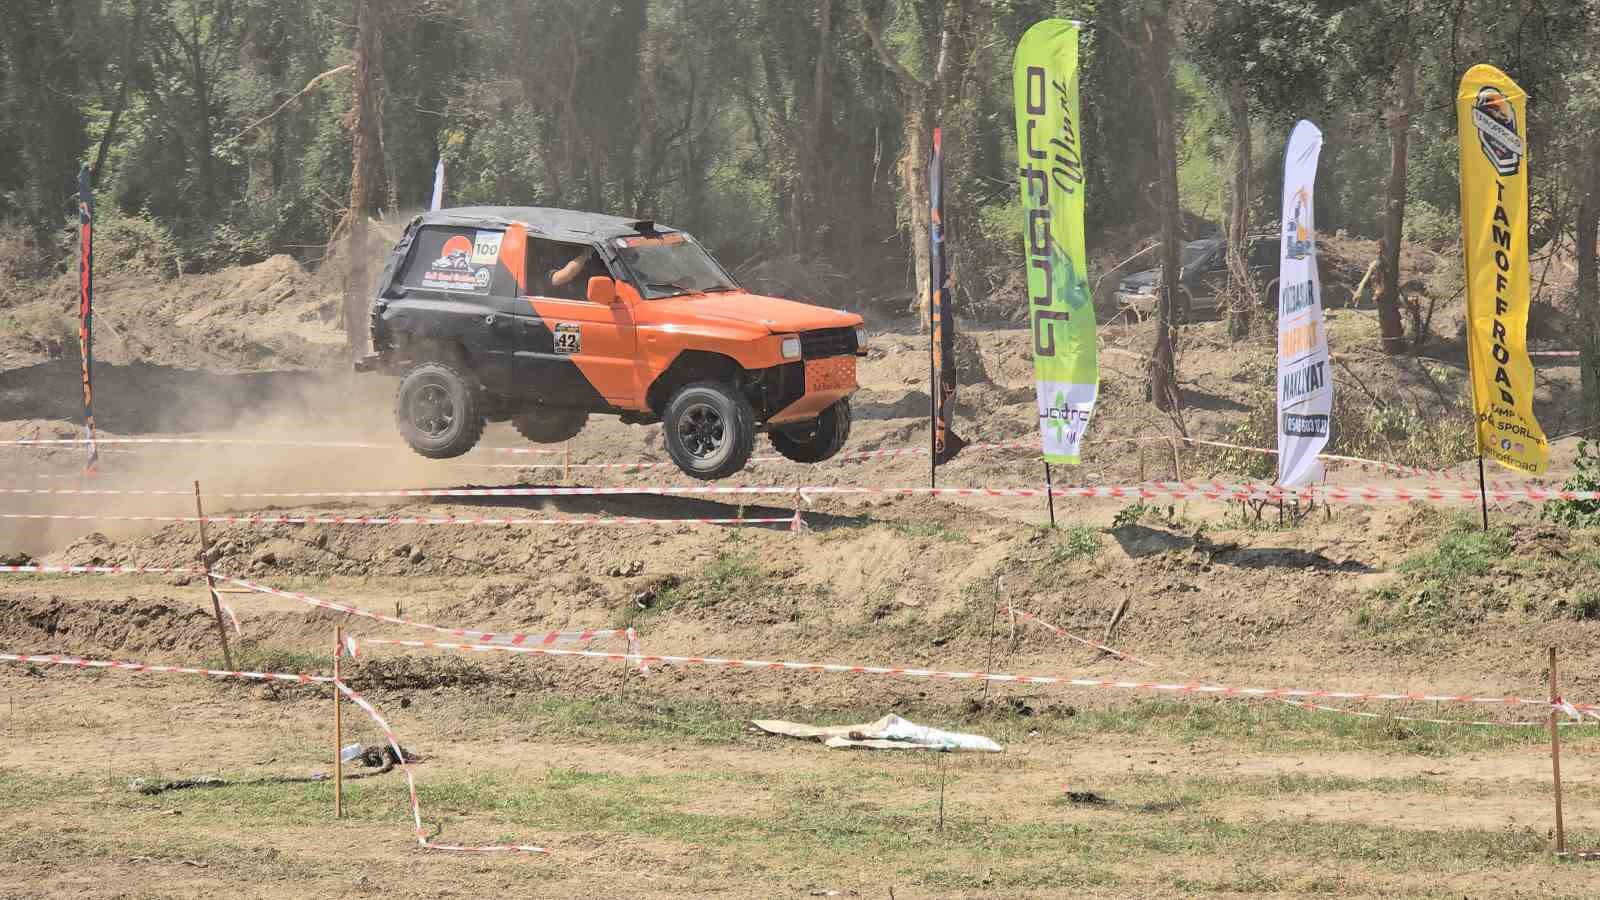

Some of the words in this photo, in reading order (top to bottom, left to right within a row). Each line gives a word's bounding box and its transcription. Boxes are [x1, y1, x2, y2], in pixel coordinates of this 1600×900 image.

[476, 243, 498, 256] 100
[559, 334, 576, 348] 42
[1282, 360, 1325, 400] NAKLİYAT
